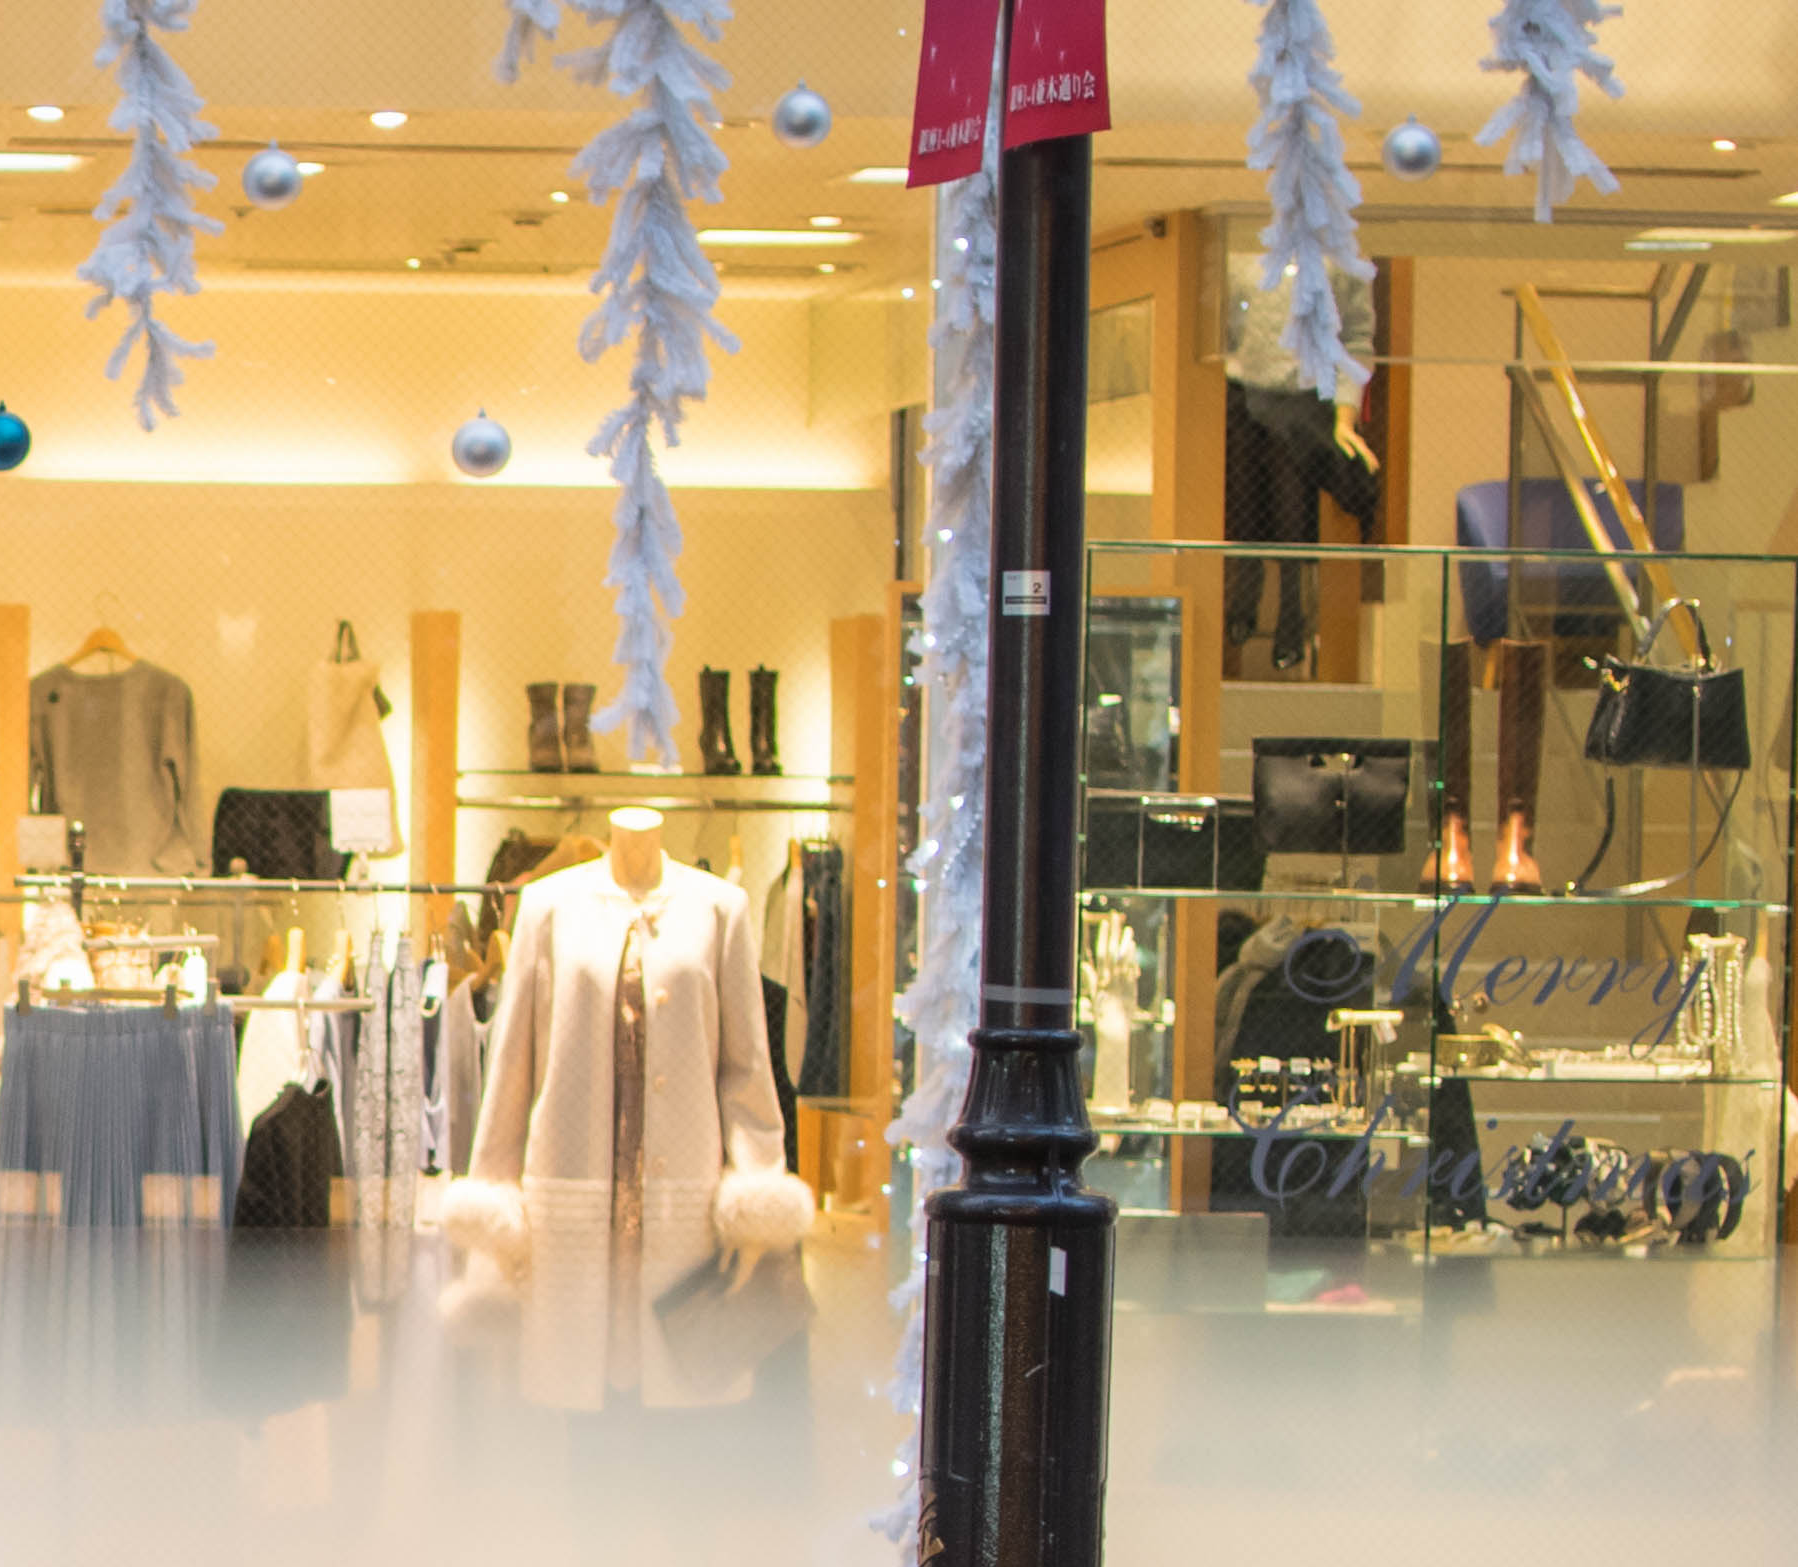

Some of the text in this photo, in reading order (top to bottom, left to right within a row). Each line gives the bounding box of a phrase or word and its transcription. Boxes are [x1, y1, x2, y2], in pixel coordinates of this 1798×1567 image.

[1032, 582, 1042, 595] 2
[1284, 886, 1710, 1060] Merry
[1228, 1070, 1761, 1210] Christmas
